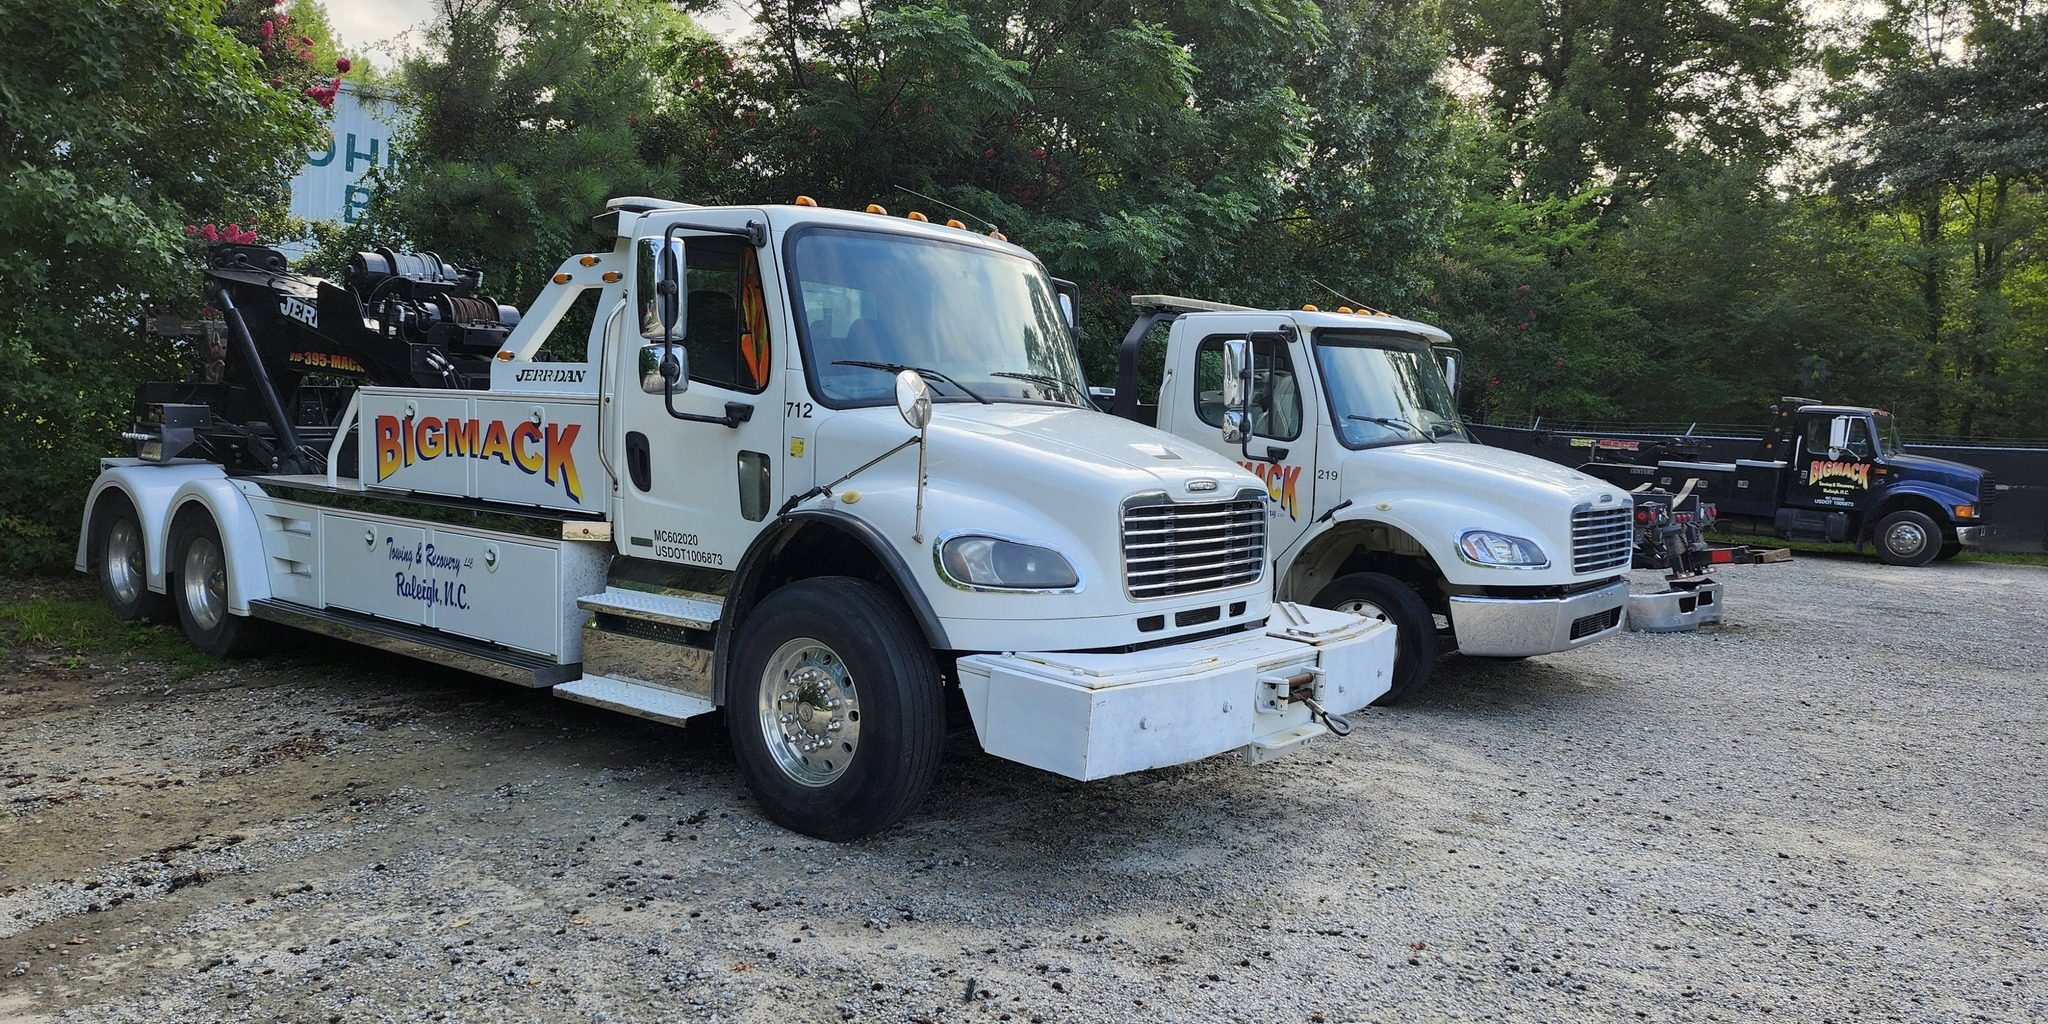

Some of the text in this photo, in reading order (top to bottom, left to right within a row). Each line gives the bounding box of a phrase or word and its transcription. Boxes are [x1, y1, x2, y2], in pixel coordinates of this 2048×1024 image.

[280, 297, 318, 329] JER
[786, 402, 813, 418] 712
[375, 415, 583, 504] BIGMACK
[1317, 469, 1338, 480] 219
[1809, 460, 1871, 490] BIGMACK
[654, 529, 698, 546] MC602020
[386, 537, 413, 570] Towing
[415, 542, 422, 564] &
[425, 544, 461, 577] Recovery
[655, 545, 723, 566] USDOT1006873
[395, 572, 470, 610] Raleigh, N.C.
